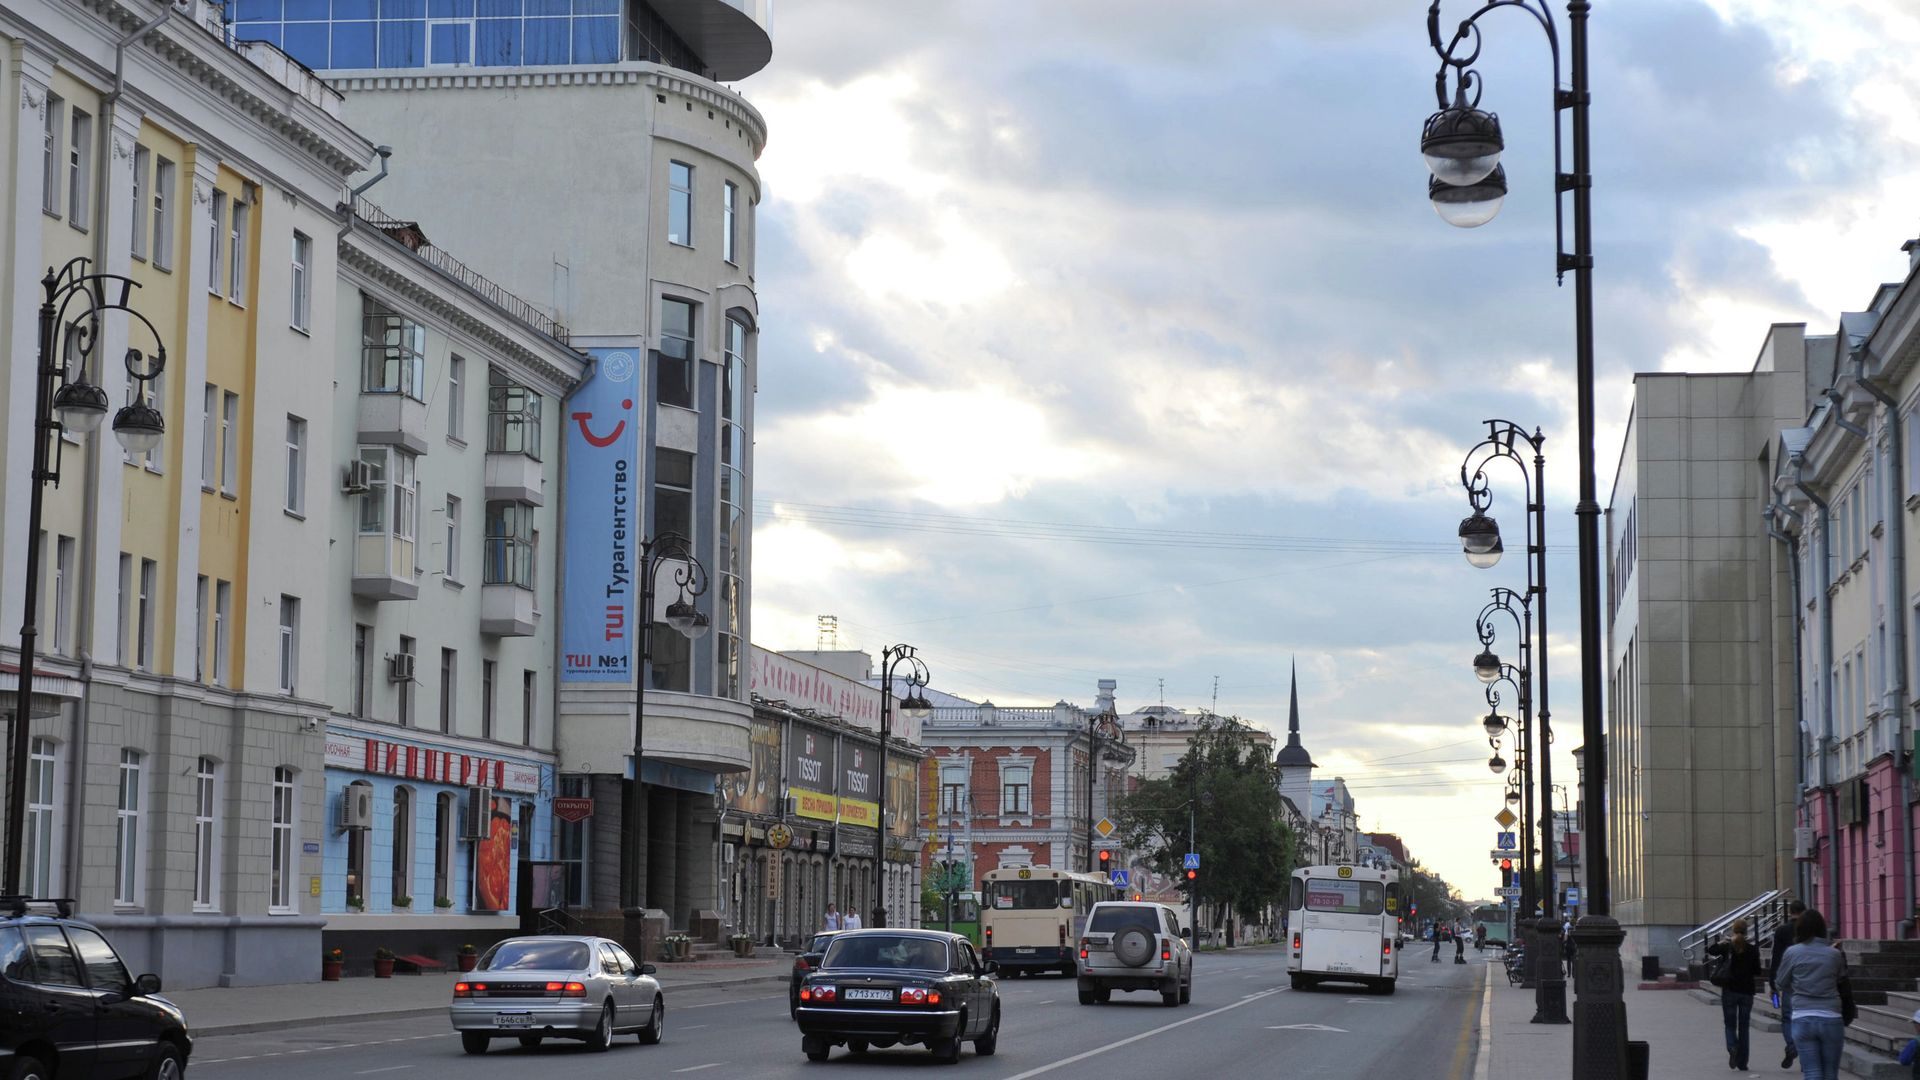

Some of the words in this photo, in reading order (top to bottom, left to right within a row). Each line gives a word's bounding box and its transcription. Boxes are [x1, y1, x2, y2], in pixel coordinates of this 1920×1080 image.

[607, 459, 629, 598] Турагентство
[606, 605, 625, 641] TUI
[566, 654, 592, 667] TUI
[598, 655, 628, 667] №1
[365, 739, 505, 790] ПИЦЦЕРИЯ
[798, 756, 822, 783] TISSOT
[847, 769, 869, 794] TISSOT
[557, 802, 589, 810] ОТКРЫТО
